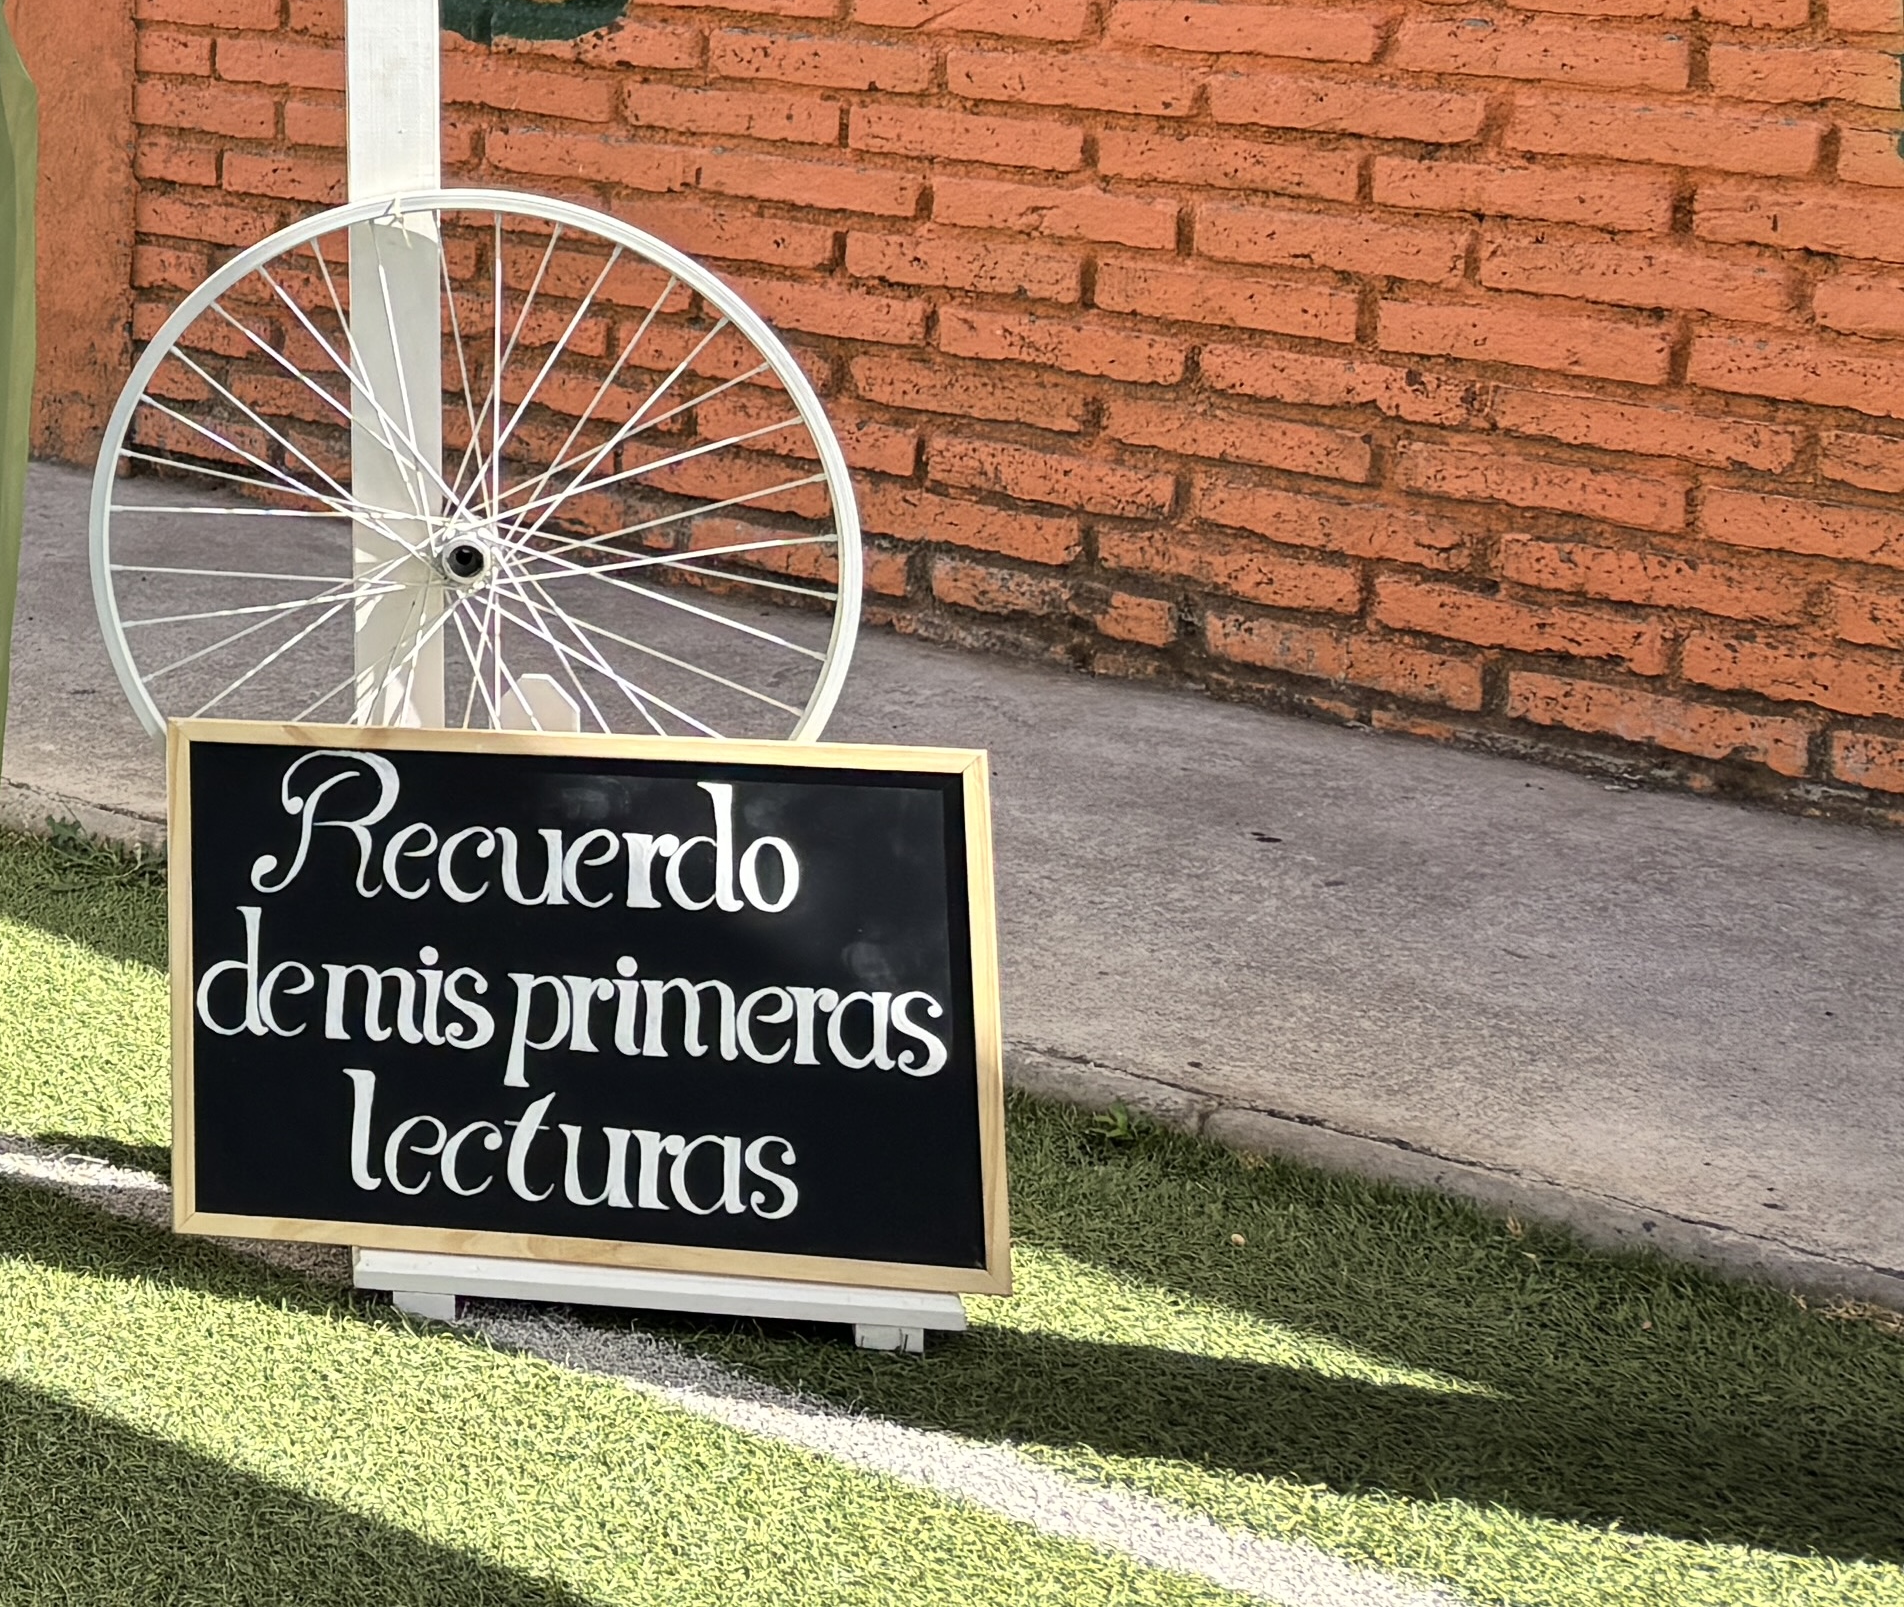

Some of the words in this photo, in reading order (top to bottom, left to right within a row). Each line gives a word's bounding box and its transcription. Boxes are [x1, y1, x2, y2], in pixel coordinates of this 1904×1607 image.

[249, 749, 801, 913] Recuerdo
[196, 906, 315, 1037] de
[322, 945, 496, 1050] mis
[503, 955, 950, 1088] primeras
[342, 1068, 800, 1220] lecturas
